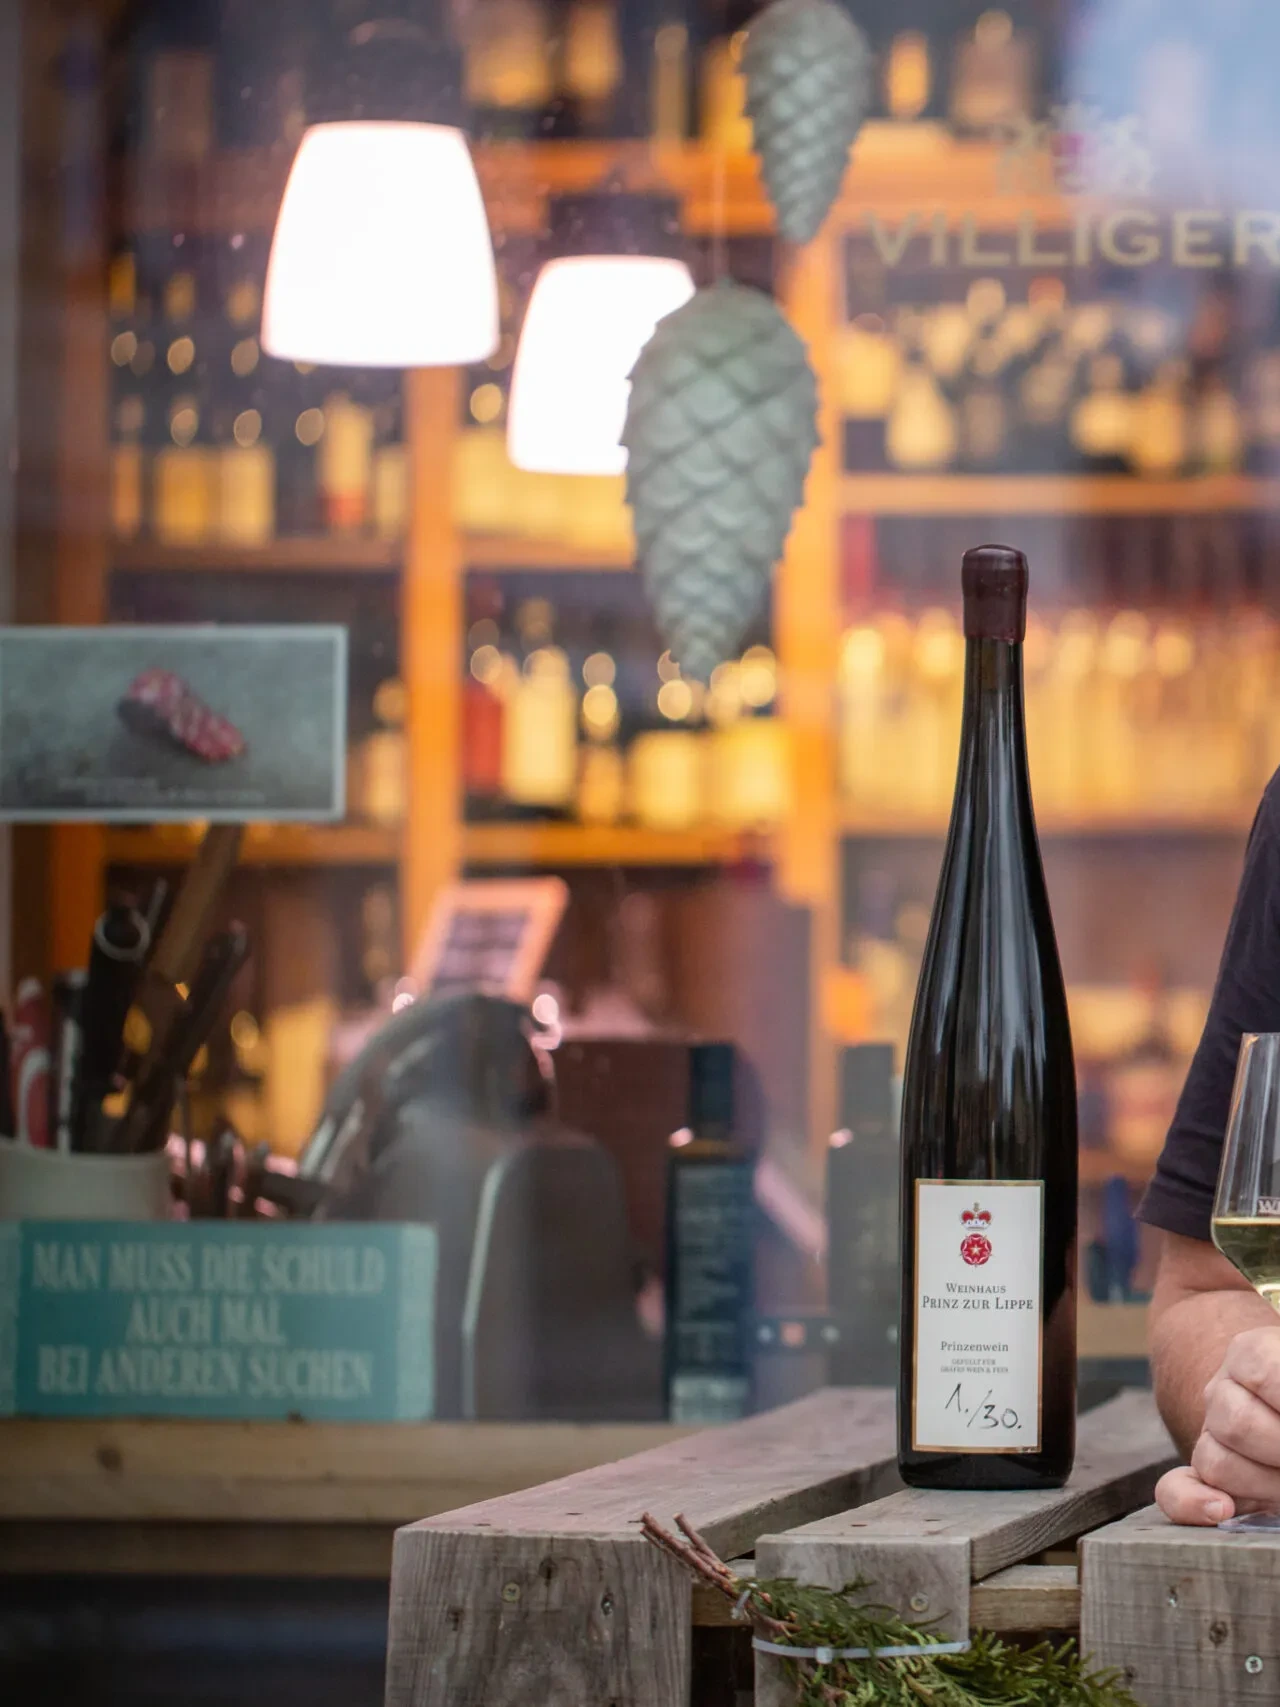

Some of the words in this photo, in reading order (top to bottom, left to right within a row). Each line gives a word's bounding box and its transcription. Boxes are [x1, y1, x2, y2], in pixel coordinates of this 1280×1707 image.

[32, 1241, 101, 1290] MAN
[109, 1242, 193, 1291] MUSS
[203, 1244, 256, 1291] DIE
[261, 1245, 386, 1294] SCHULD
[126, 1296, 212, 1344] AUCH
[220, 1297, 287, 1346] MAL
[36, 1344, 89, 1394] BEI
[97, 1346, 240, 1397] ANDEREN
[248, 1349, 374, 1397] SUCHEN
[940, 1341, 1009, 1353] Prinzenwein
